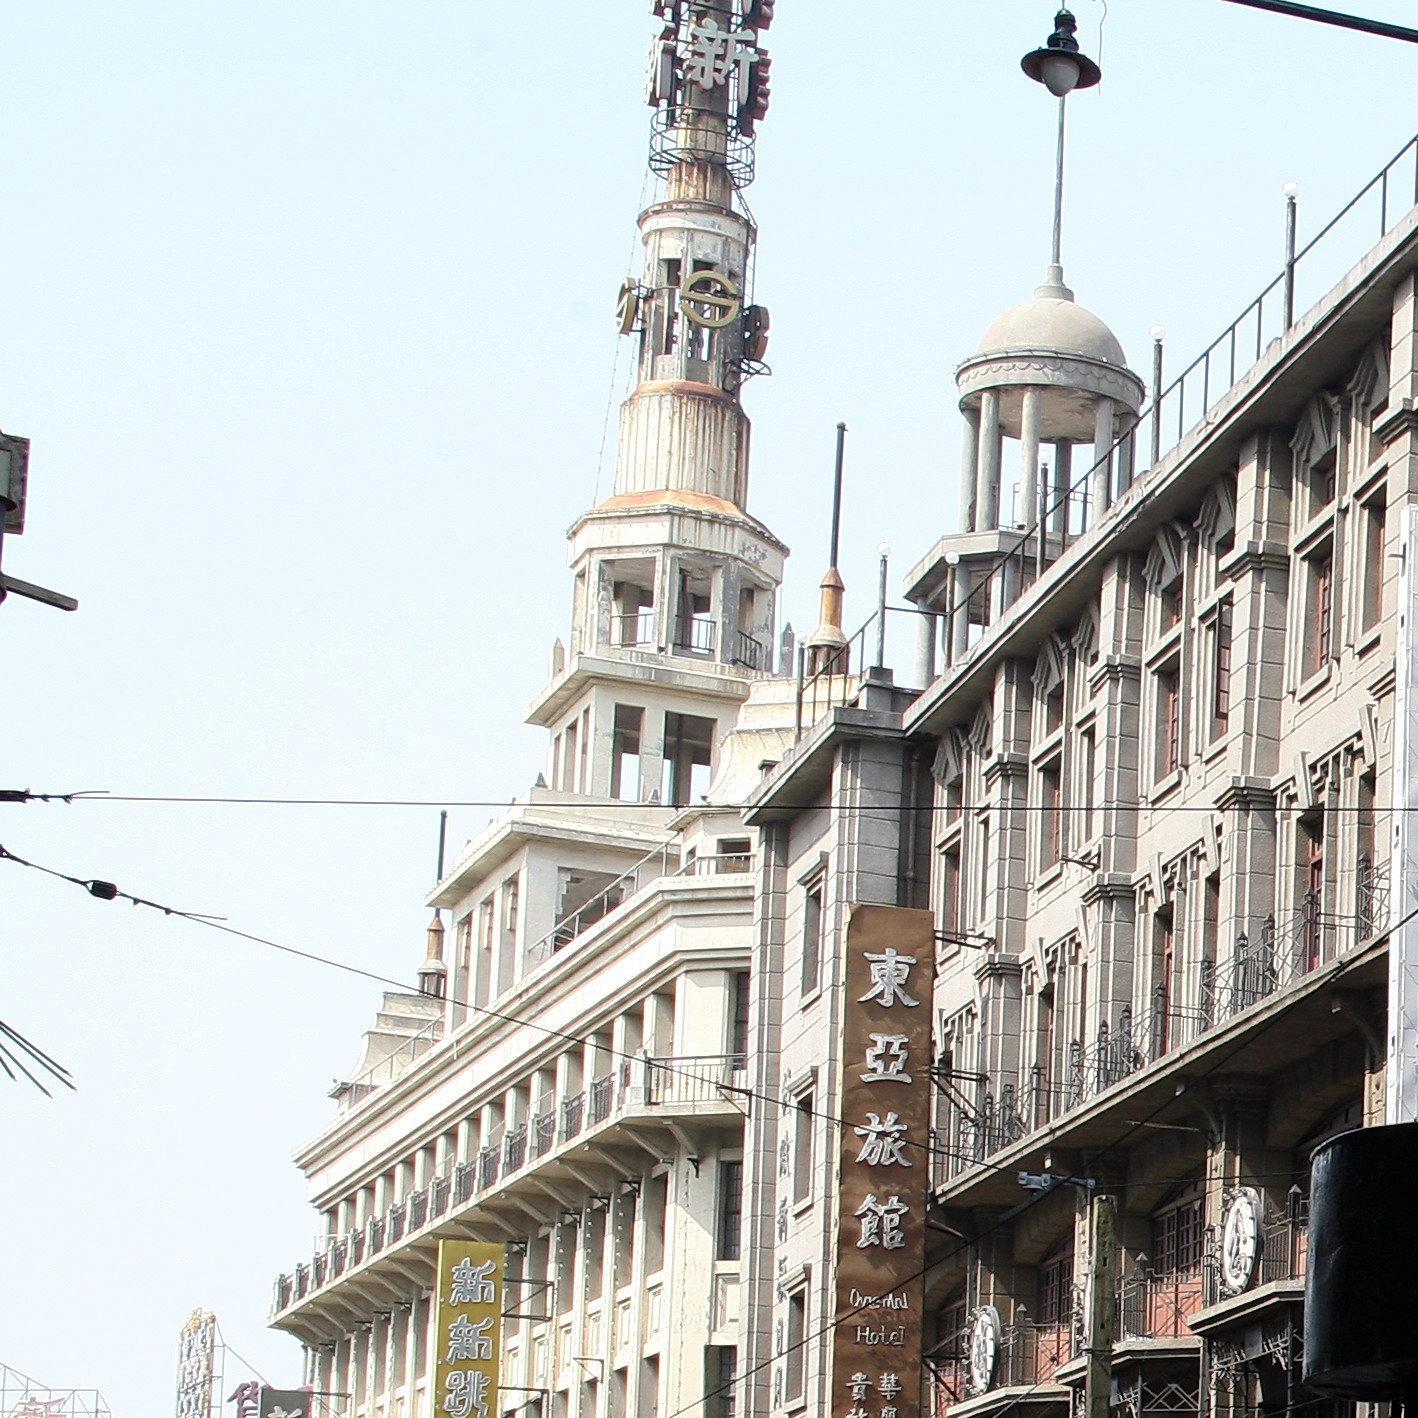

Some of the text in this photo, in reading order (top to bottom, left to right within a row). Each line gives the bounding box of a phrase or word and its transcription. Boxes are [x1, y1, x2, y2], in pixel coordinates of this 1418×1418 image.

[684, 18, 759, 105] 新
[853, 948, 920, 1250] 東亞旅館
[856, 1325, 905, 1345] Hotel
